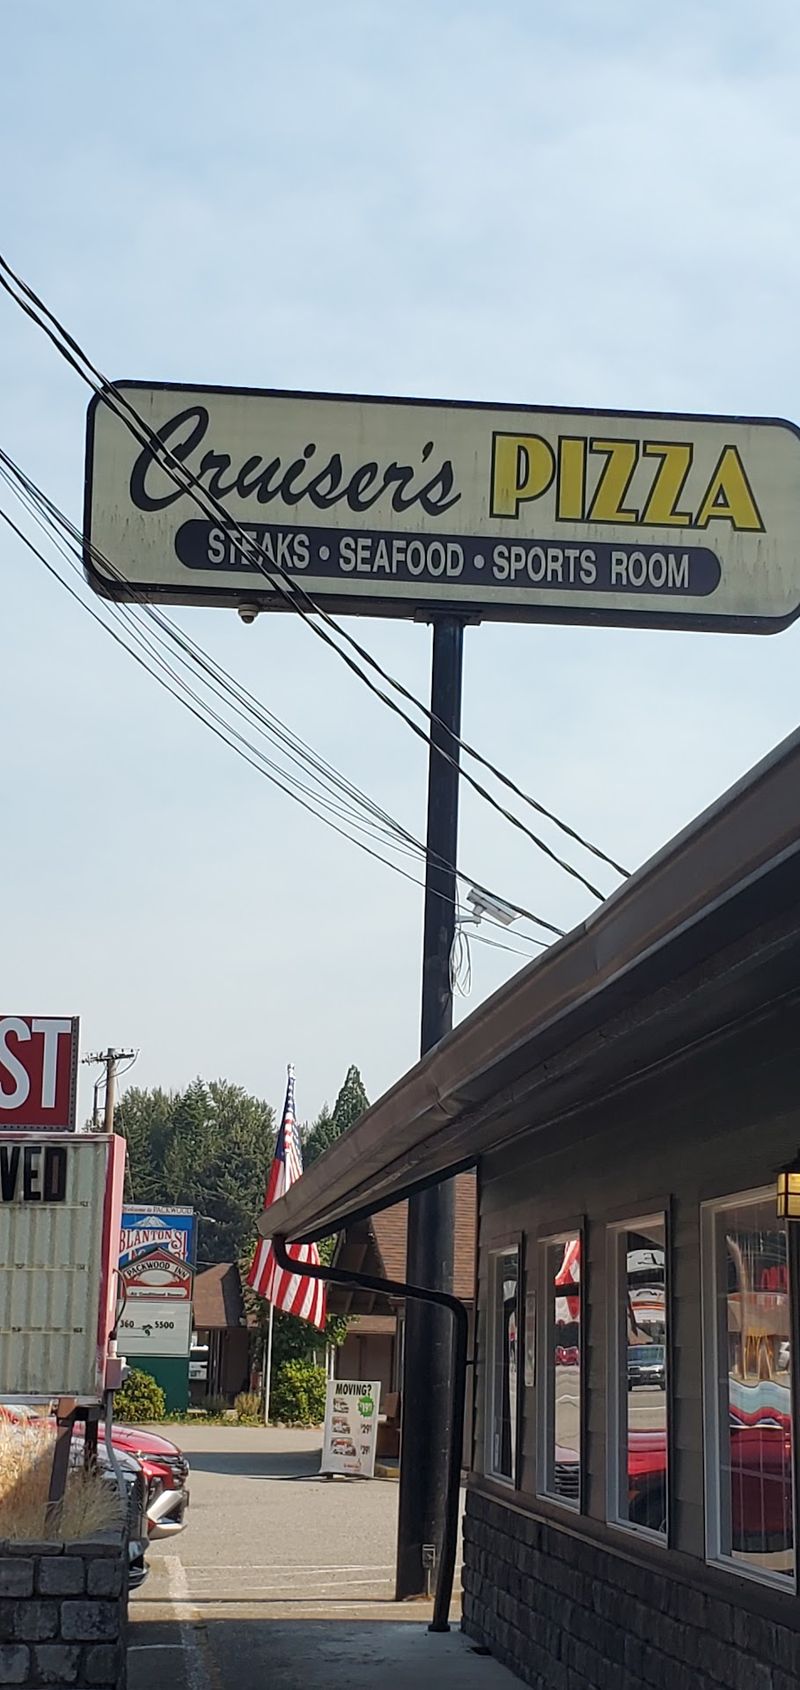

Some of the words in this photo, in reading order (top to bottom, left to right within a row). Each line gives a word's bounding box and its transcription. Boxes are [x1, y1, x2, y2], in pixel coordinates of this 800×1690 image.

[130, 406, 462, 516] Cruiser's
[489, 431, 767, 533] PIZZA
[207, 527, 310, 569] STEAKS
[339, 536, 465, 577] SEAFOOD
[492, 545, 597, 585] SPORTS
[611, 551, 689, 588] ROOM
[0, 1017, 72, 1109] ST
[0, 1146, 67, 1201] VED
[120, 1229, 183, 1253] BLANTON'S
[126, 1261, 170, 1277] PACKWOOD
[175, 1266, 188, 1278] INN
[120, 1320, 135, 1328] 360
[154, 1321, 175, 1329] 5500
[335, 1383, 372, 1396] MOVING?
